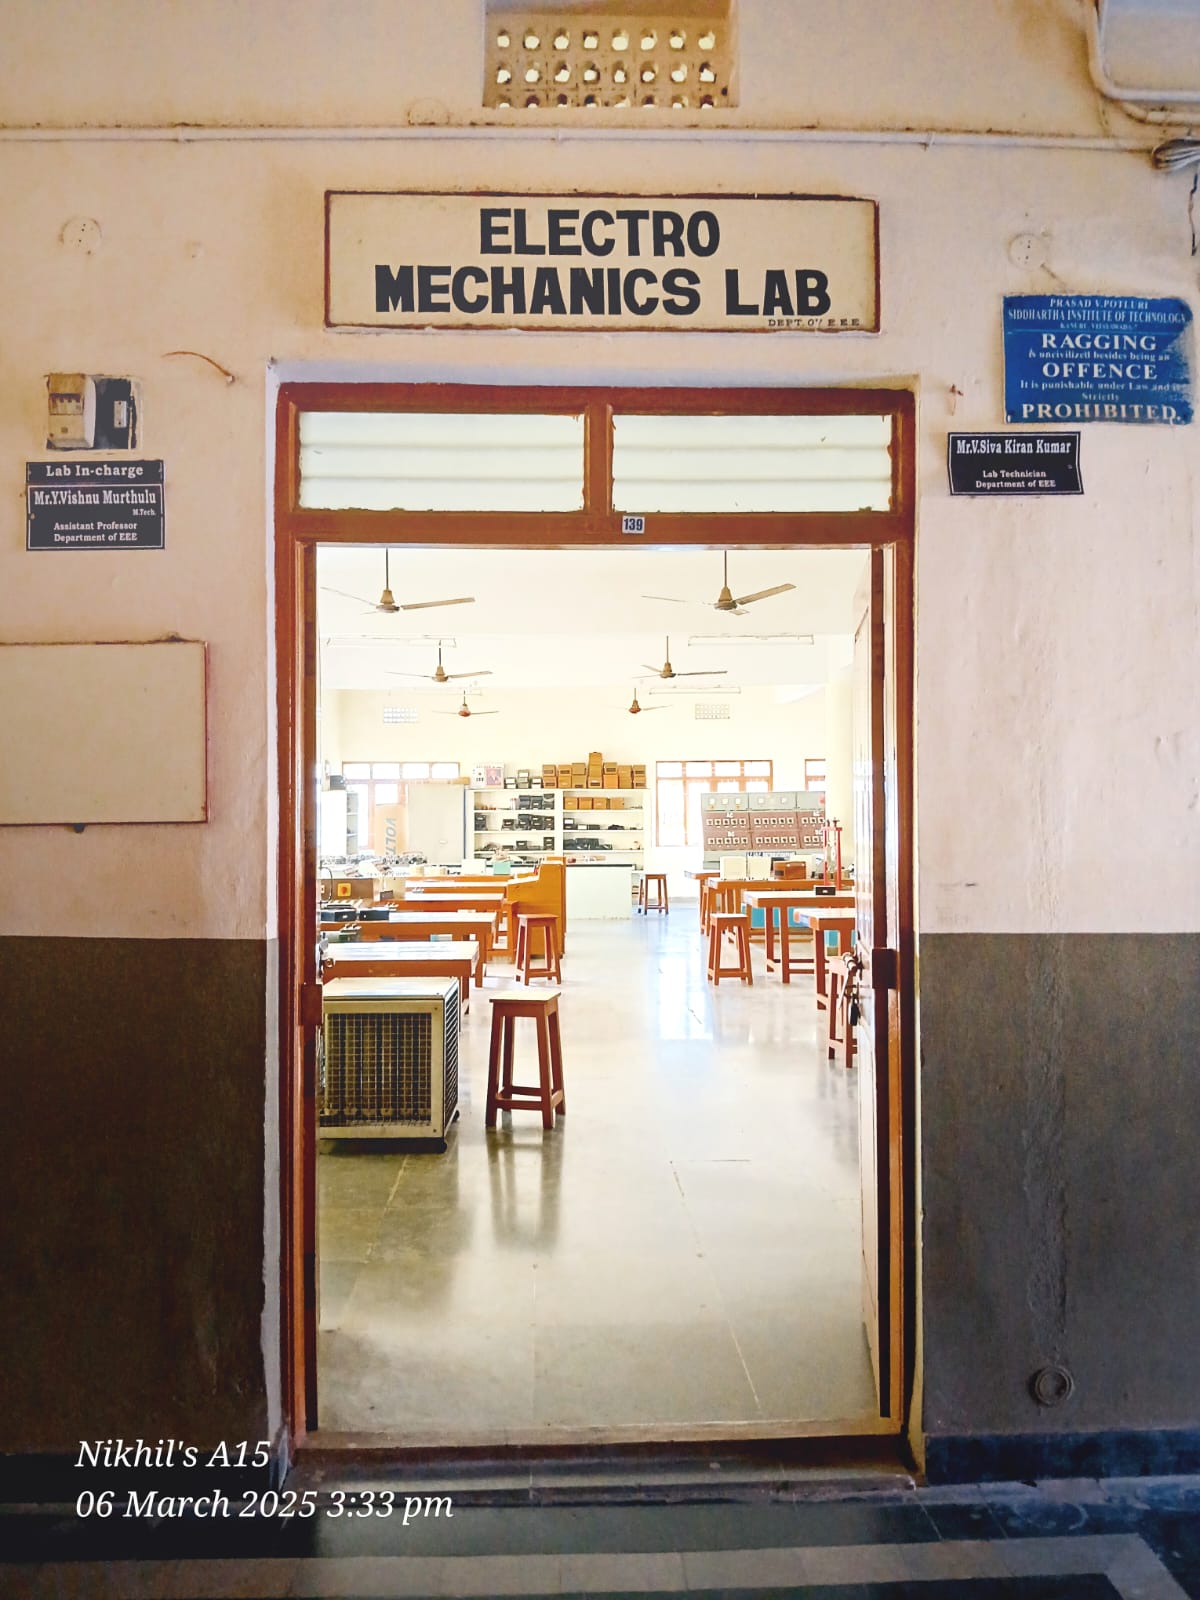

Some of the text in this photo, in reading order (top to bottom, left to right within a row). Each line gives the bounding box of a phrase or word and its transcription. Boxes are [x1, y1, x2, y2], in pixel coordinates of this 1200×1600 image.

[480, 208, 720, 257] ELECTRO
[375, 264, 831, 316] MECHANICS LAB
[1050, 298, 1092, 308] PRASAD
[1008, 308, 1065, 321] SIDDHARTHA
[1114, 310, 1126, 322] OF
[1042, 333, 1157, 351] RAGGING
[1039, 350, 1091, 360] uncivilized
[1093, 351, 1127, 360] besides
[1130, 352, 1156, 362] being
[1042, 361, 1158, 380] OFFENCE
[1020, 379, 1029, 389] It
[1031, 379, 1039, 389] is
[1041, 380, 1094, 391] punishable
[1097, 381, 1126, 390] under
[1152, 382, 1170, 392] and
[1022, 402, 1182, 421] PROHIBITED.
[956, 439, 1071, 454] Mr.V.Siva Kiran Kumar
[46, 464, 144, 479] Lab In-charge
[982, 470, 1047, 478] Lab Technician
[975, 479, 1056, 490] Department of EEE
[102, 489, 156, 505] Murthulu
[53, 522, 138, 531] Assistant Professor
[623, 518, 643, 531] 139
[53, 532, 138, 544] Department of EEE
[384, 817, 397, 856] VOLT
